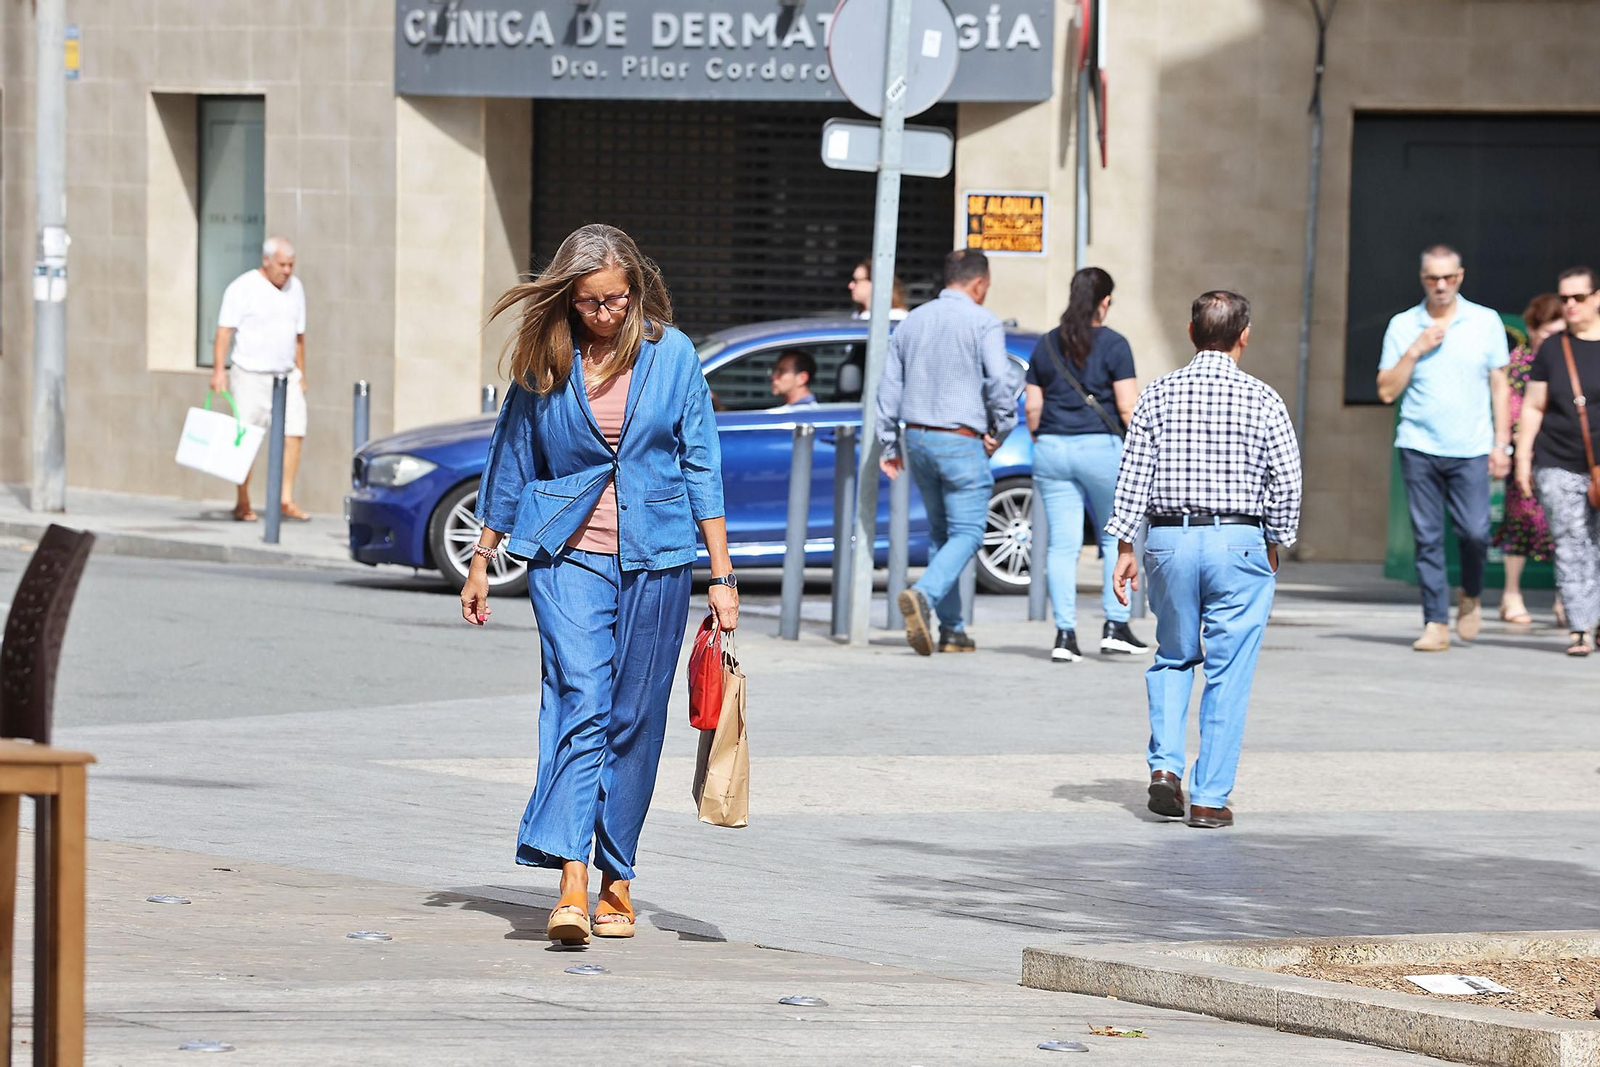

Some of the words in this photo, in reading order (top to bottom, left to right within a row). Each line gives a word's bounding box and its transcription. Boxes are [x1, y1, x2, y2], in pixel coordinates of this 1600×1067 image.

[576, 11, 628, 47] DE
[651, 4, 1042, 50] DERMATGÍA
[551, 55, 608, 79] Dra.
[621, 55, 691, 79] Pilar
[705, 57, 831, 82] Cordero
